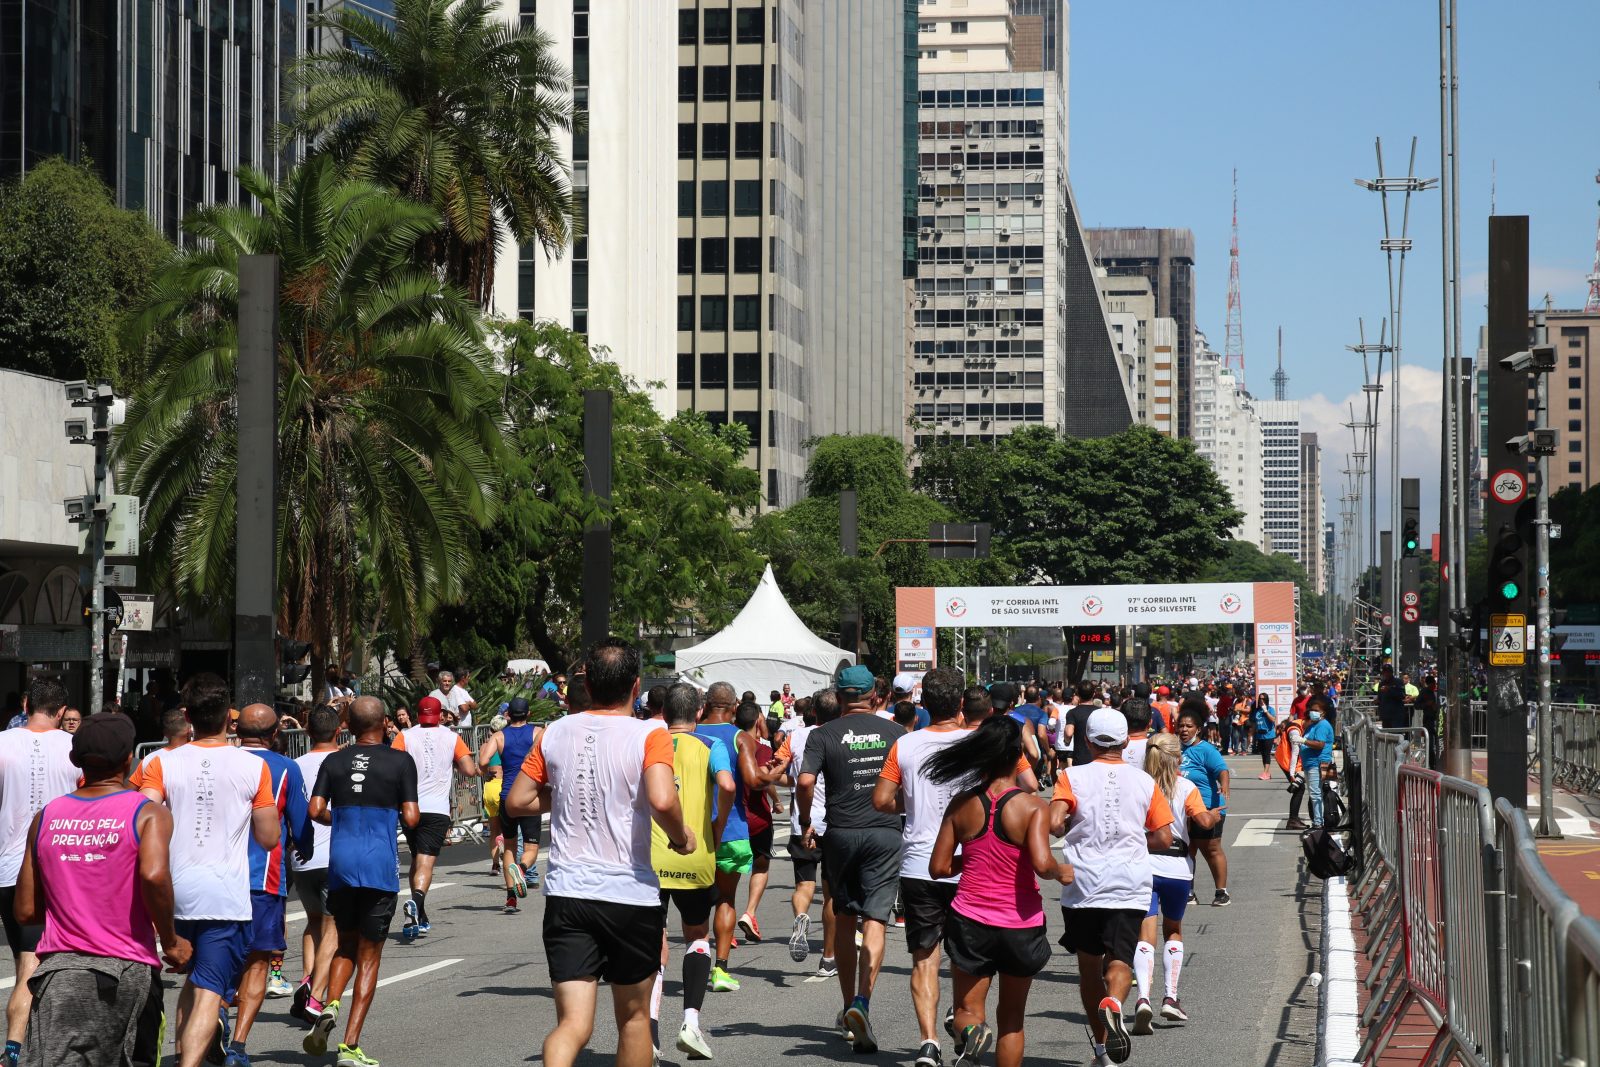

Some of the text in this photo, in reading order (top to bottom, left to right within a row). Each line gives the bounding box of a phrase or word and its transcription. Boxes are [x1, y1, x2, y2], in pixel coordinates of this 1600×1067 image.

[841, 730, 880, 744] ADEMIR
[850, 741, 886, 750] PAULINO
[50, 819, 126, 830] JUNTOS PELA
[52, 832, 119, 847] PREVENÇÃO
